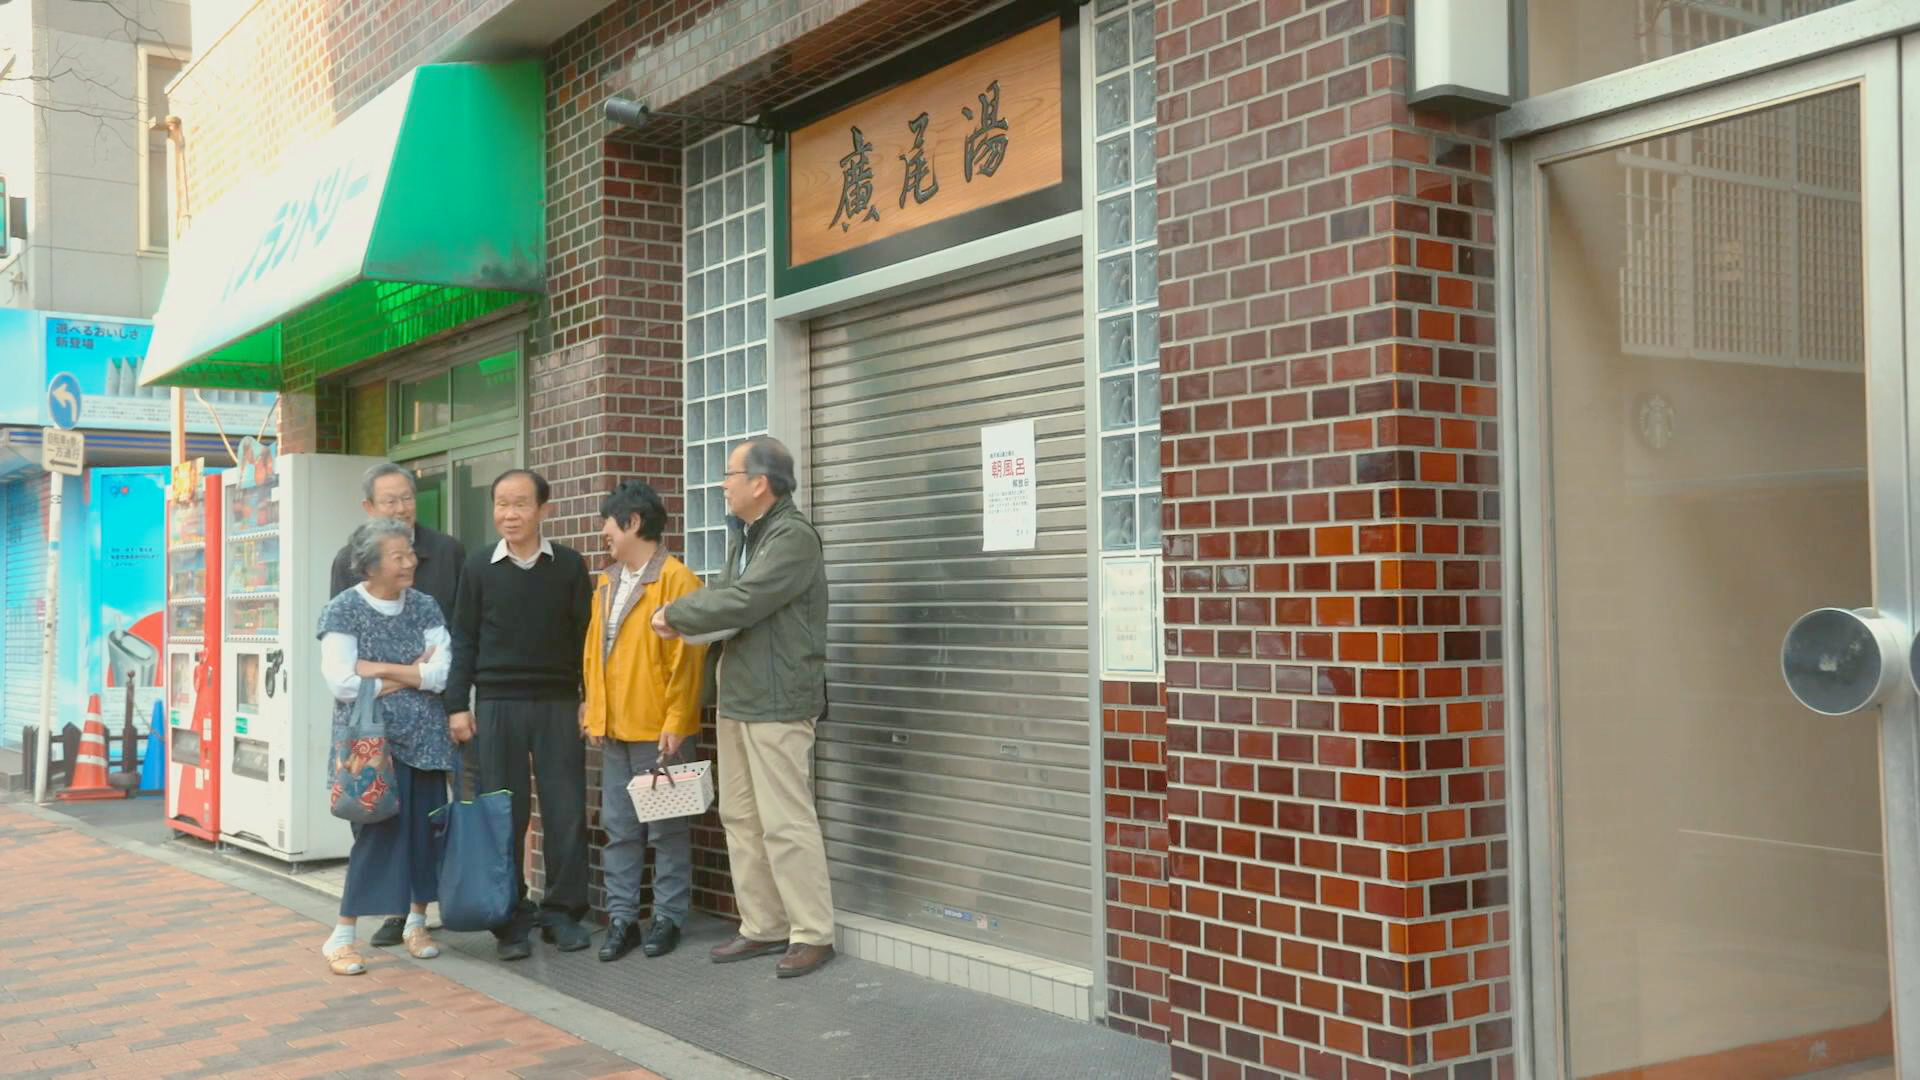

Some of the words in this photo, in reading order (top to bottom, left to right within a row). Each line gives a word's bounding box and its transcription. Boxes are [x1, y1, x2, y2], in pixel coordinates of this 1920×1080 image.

[828, 79, 1009, 233] 廣尾湯
[47, 446, 81, 461] 一方通行
[991, 457, 1026, 479] 朝風呂
